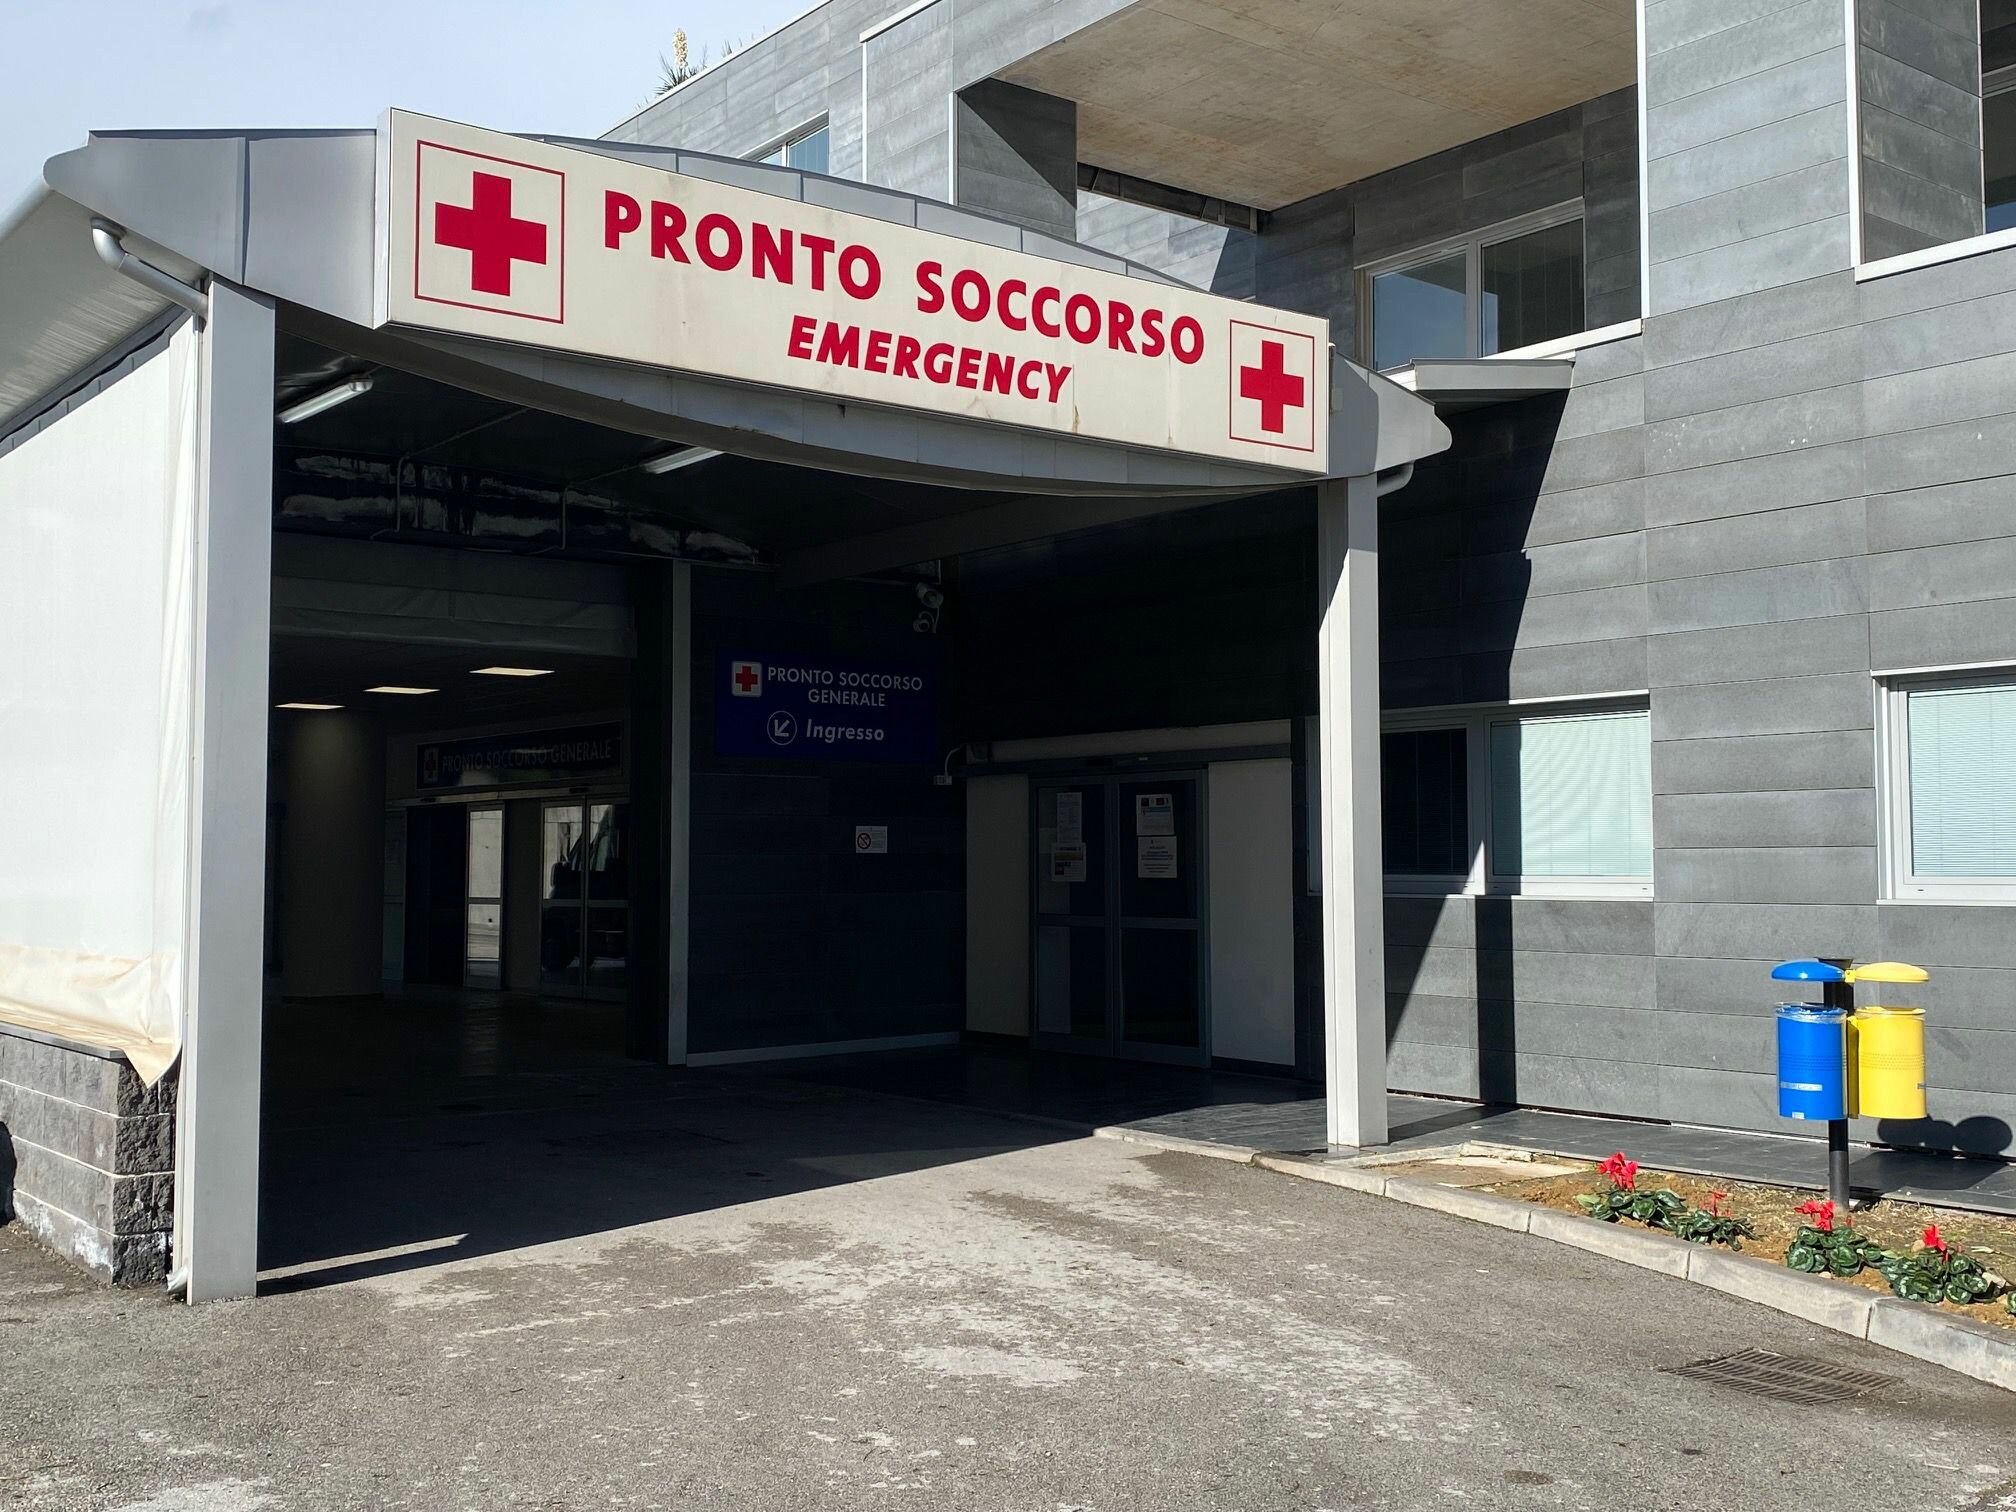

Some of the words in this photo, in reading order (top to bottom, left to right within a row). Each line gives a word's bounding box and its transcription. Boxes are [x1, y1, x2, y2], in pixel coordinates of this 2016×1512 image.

[604, 190, 882, 300] PRONTO
[916, 260, 1205, 365] SOCCORSO
[787, 315, 1072, 404] EMERGENCY
[768, 667, 833, 684] PRONTO
[839, 672, 923, 691] SOCCORSO
[808, 689, 886, 707] GENERALE
[806, 718, 885, 743] Ingresso
[443, 752, 483, 772] PRONTO
[551, 739, 612, 763] GENERALE
